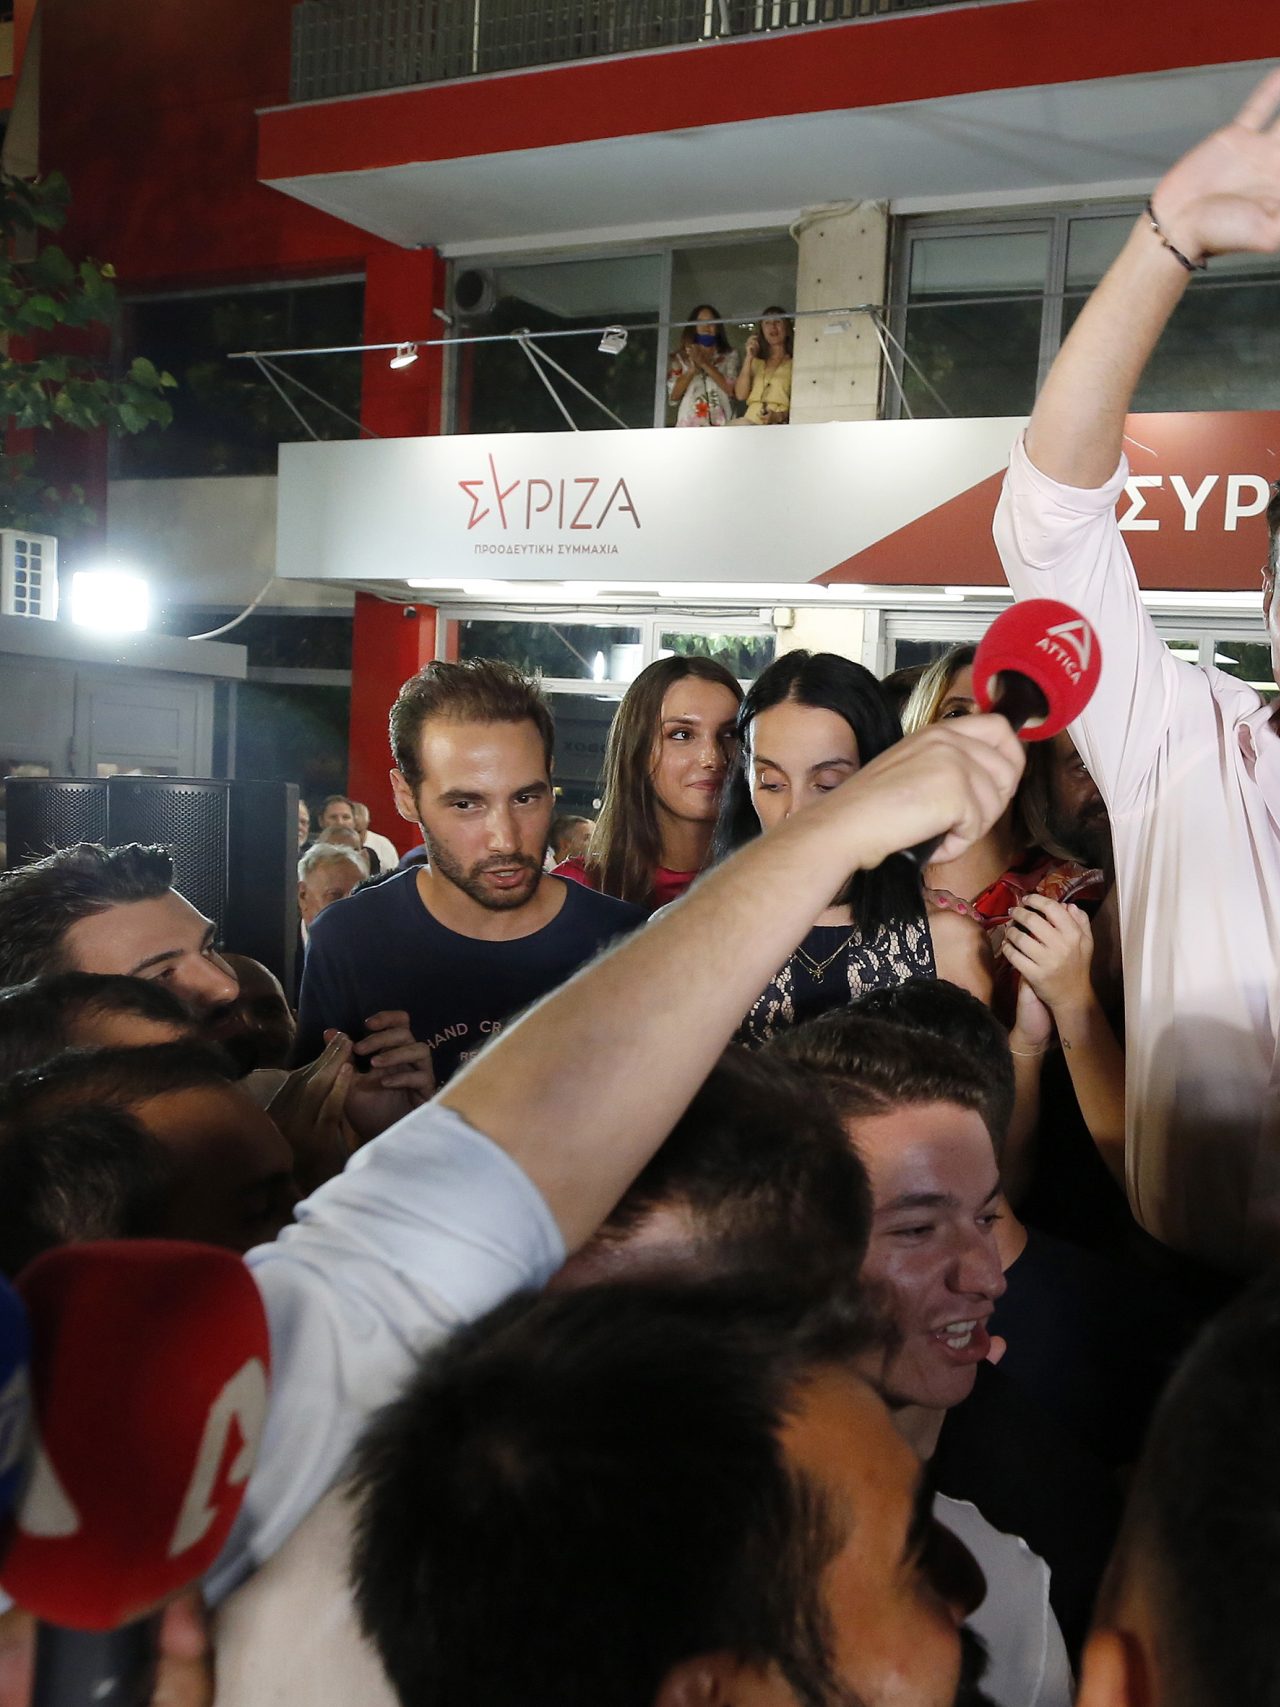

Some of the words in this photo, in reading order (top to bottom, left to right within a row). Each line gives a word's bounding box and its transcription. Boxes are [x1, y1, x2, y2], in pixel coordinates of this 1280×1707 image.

[474, 544, 553, 555] ΠΡΟΟΔΕΥΤΙΚΗ
[557, 543, 619, 555] ΣΥΜΜΑΧΙΑ
[1035, 637, 1082, 685] ATTICA
